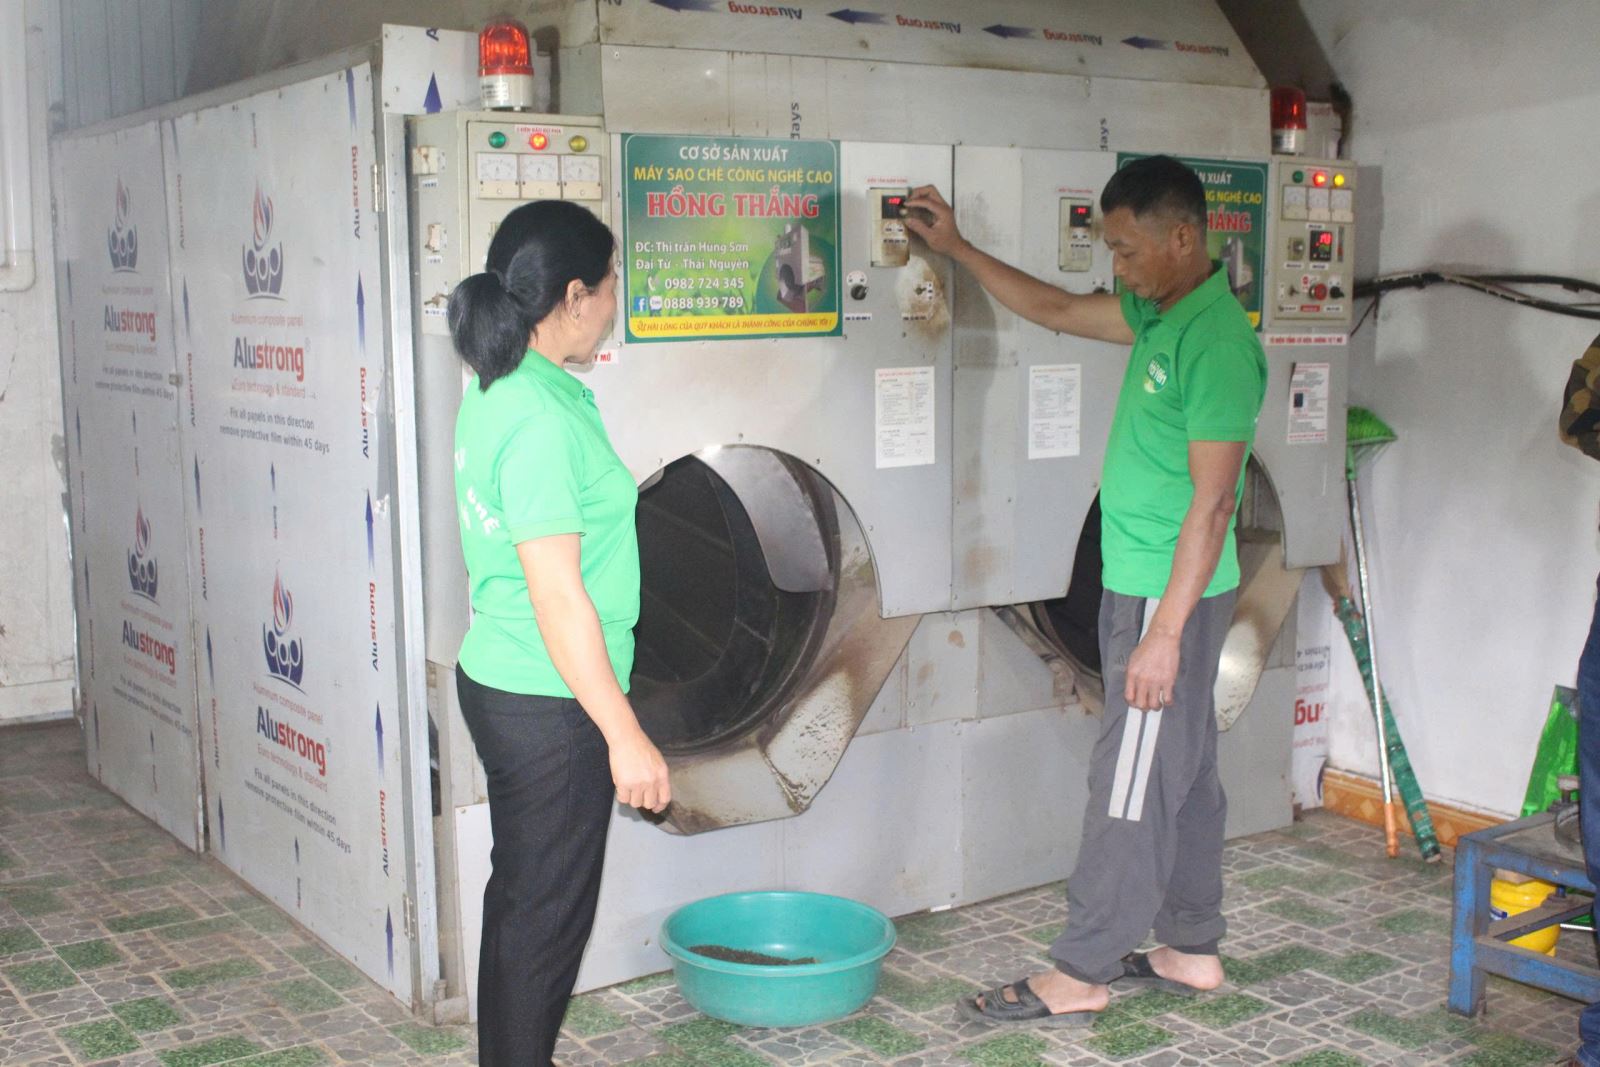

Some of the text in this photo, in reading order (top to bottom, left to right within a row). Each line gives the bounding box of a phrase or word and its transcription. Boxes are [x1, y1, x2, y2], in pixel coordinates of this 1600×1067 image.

[728, 1, 803, 20] Alustrong
[895, 14, 961, 34] Alustrong
[680, 144, 788, 162] CƠ SỞ SẢN XUẤT
[634, 164, 663, 180] MÁY
[667, 167, 694, 181] SAO
[727, 167, 765, 182] CÔNG
[806, 170, 833, 183] CAO
[351, 145, 361, 240] Alustrong
[1243, 192, 1262, 205] CAO
[635, 242, 654, 252] ĐC:
[665, 278, 744, 289] 0982 724 345
[664, 297, 693, 309] 0888
[696, 297, 719, 309] 939
[722, 296, 744, 308] 789
[104, 304, 156, 342] Alustrong
[233, 336, 304, 382] Alustrong
[287, 414, 315, 430] direction
[359, 367, 369, 458] Alustrong
[304, 437, 313, 450] 45
[314, 438, 331, 455] days
[369, 582, 379, 671] Alustrong
[122, 620, 175, 675] Alustrong
[257, 705, 326, 777] Alustrong
[310, 796, 337, 826] direction
[306, 813, 326, 837] within
[326, 826, 336, 842] 45
[336, 832, 352, 854] days
[379, 789, 390, 877] Alustrong
